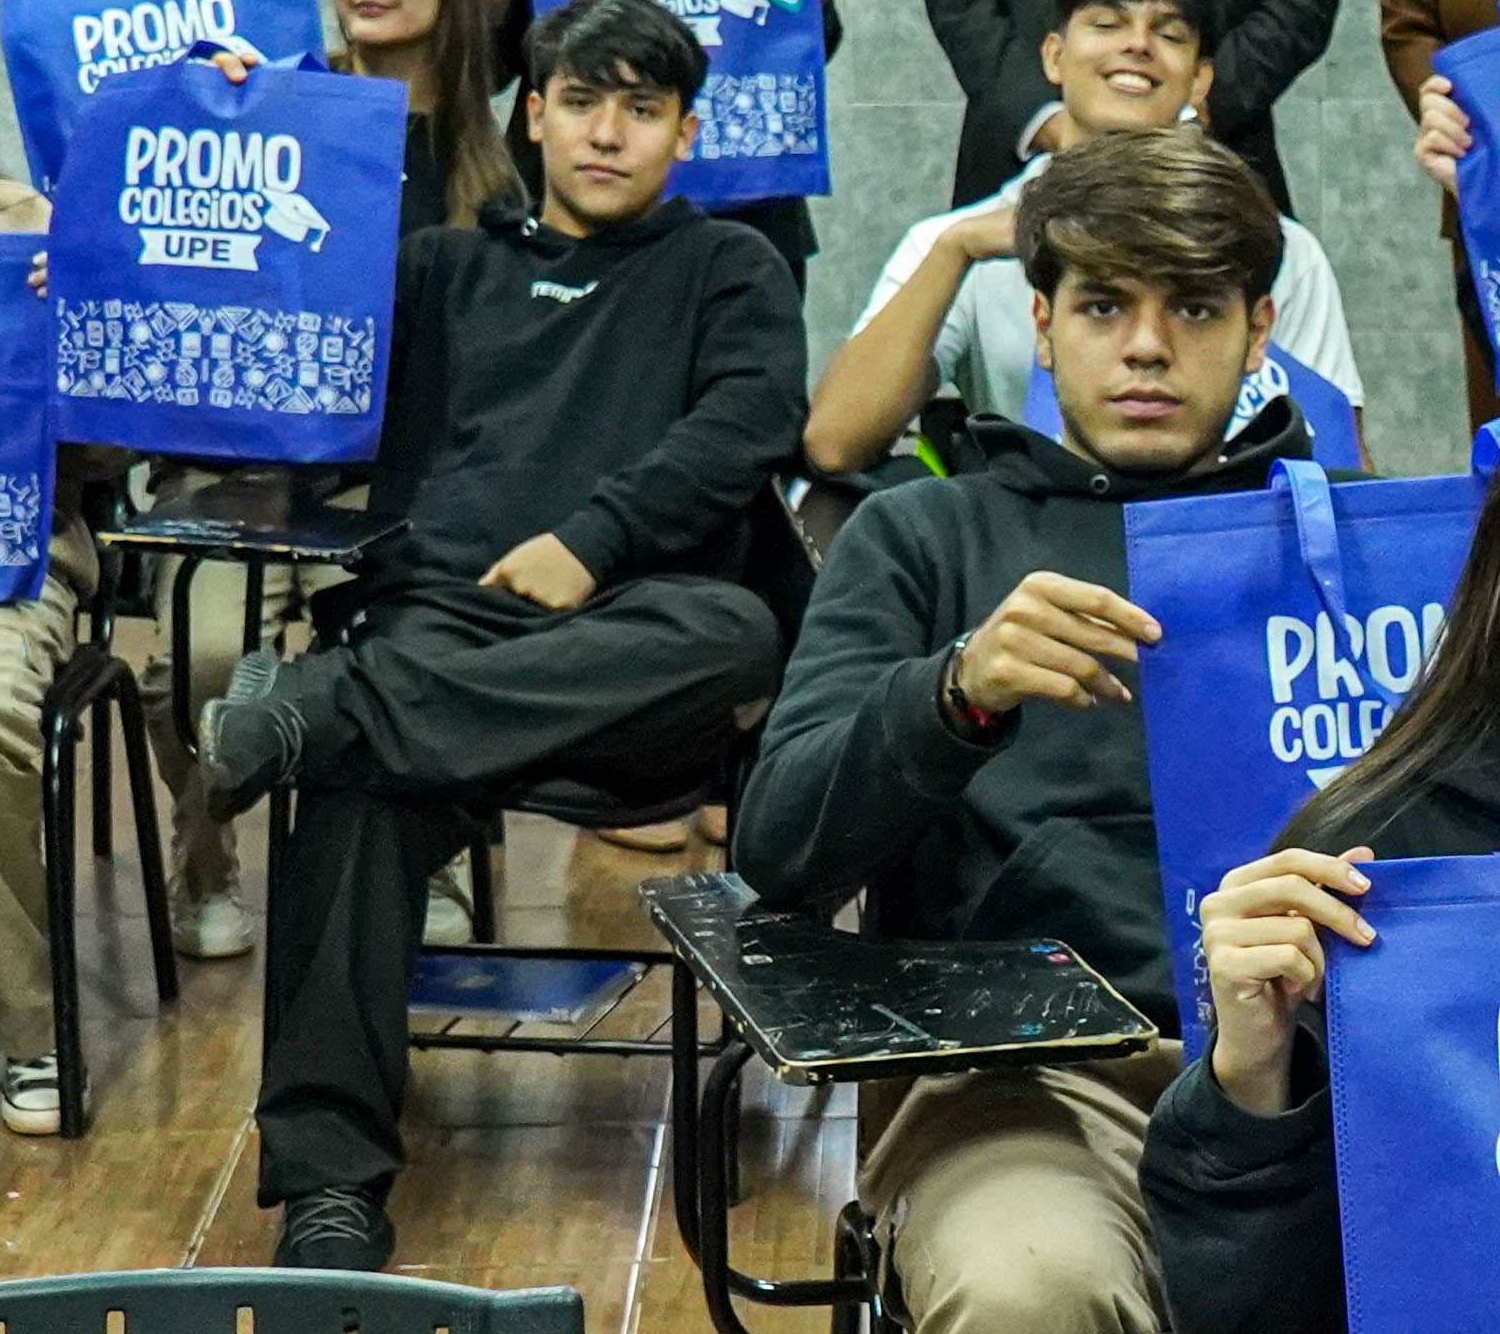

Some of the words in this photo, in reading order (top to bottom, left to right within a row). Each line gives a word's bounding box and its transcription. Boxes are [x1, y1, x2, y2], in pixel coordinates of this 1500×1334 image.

[125, 127, 302, 193] PROMO
[162, 235, 232, 263] UPE
[1266, 602, 1446, 704] PRO
